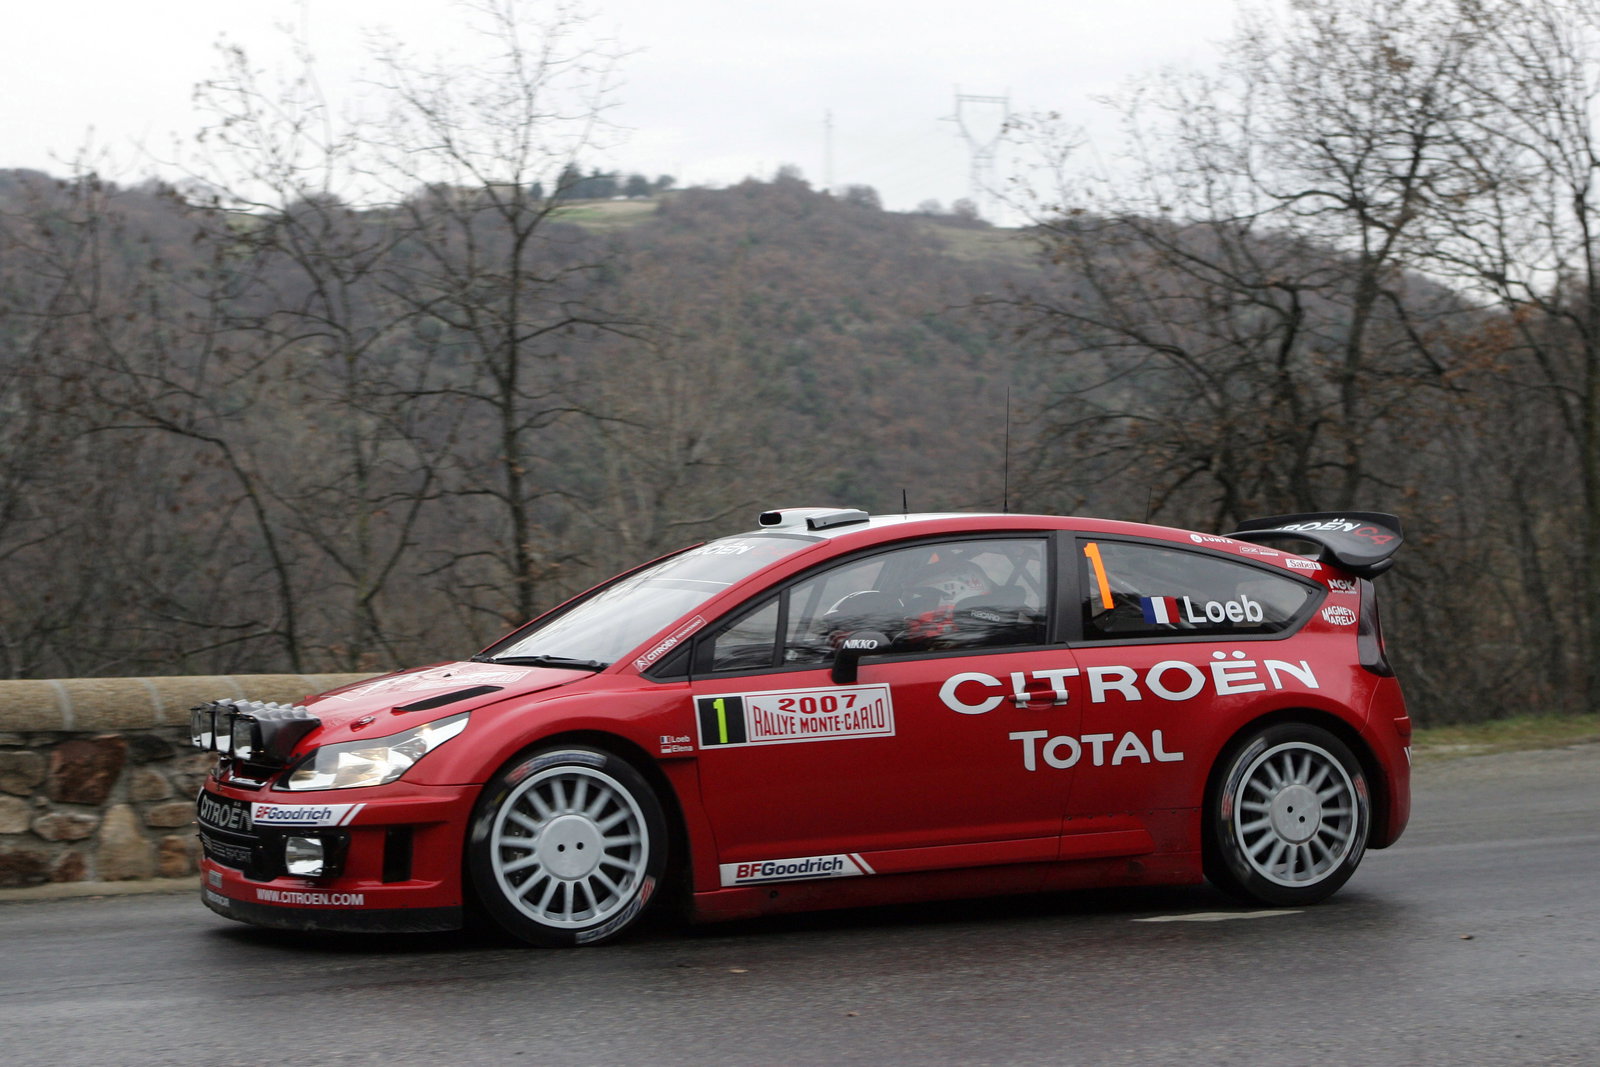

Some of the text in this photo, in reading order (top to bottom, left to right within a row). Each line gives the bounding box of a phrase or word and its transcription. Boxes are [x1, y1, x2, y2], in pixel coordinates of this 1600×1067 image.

[1083, 542, 1115, 609] 1
[1327, 578, 1355, 591] NGK
[1183, 594, 1264, 624] Loeb
[843, 639, 878, 650] NIKKO
[938, 650, 1320, 715] CITROËN
[752, 698, 885, 737] RALLYE MONTE-CARLO
[777, 694, 858, 714] 2007
[713, 698, 728, 743] 1
[1009, 729, 1184, 771] TOTAL
[201, 795, 253, 831] CITROËN
[255, 806, 332, 820] BFGoodrich
[736, 857, 843, 878] BFGoodrich
[255, 888, 364, 905] WWW.CITROEN.COM
